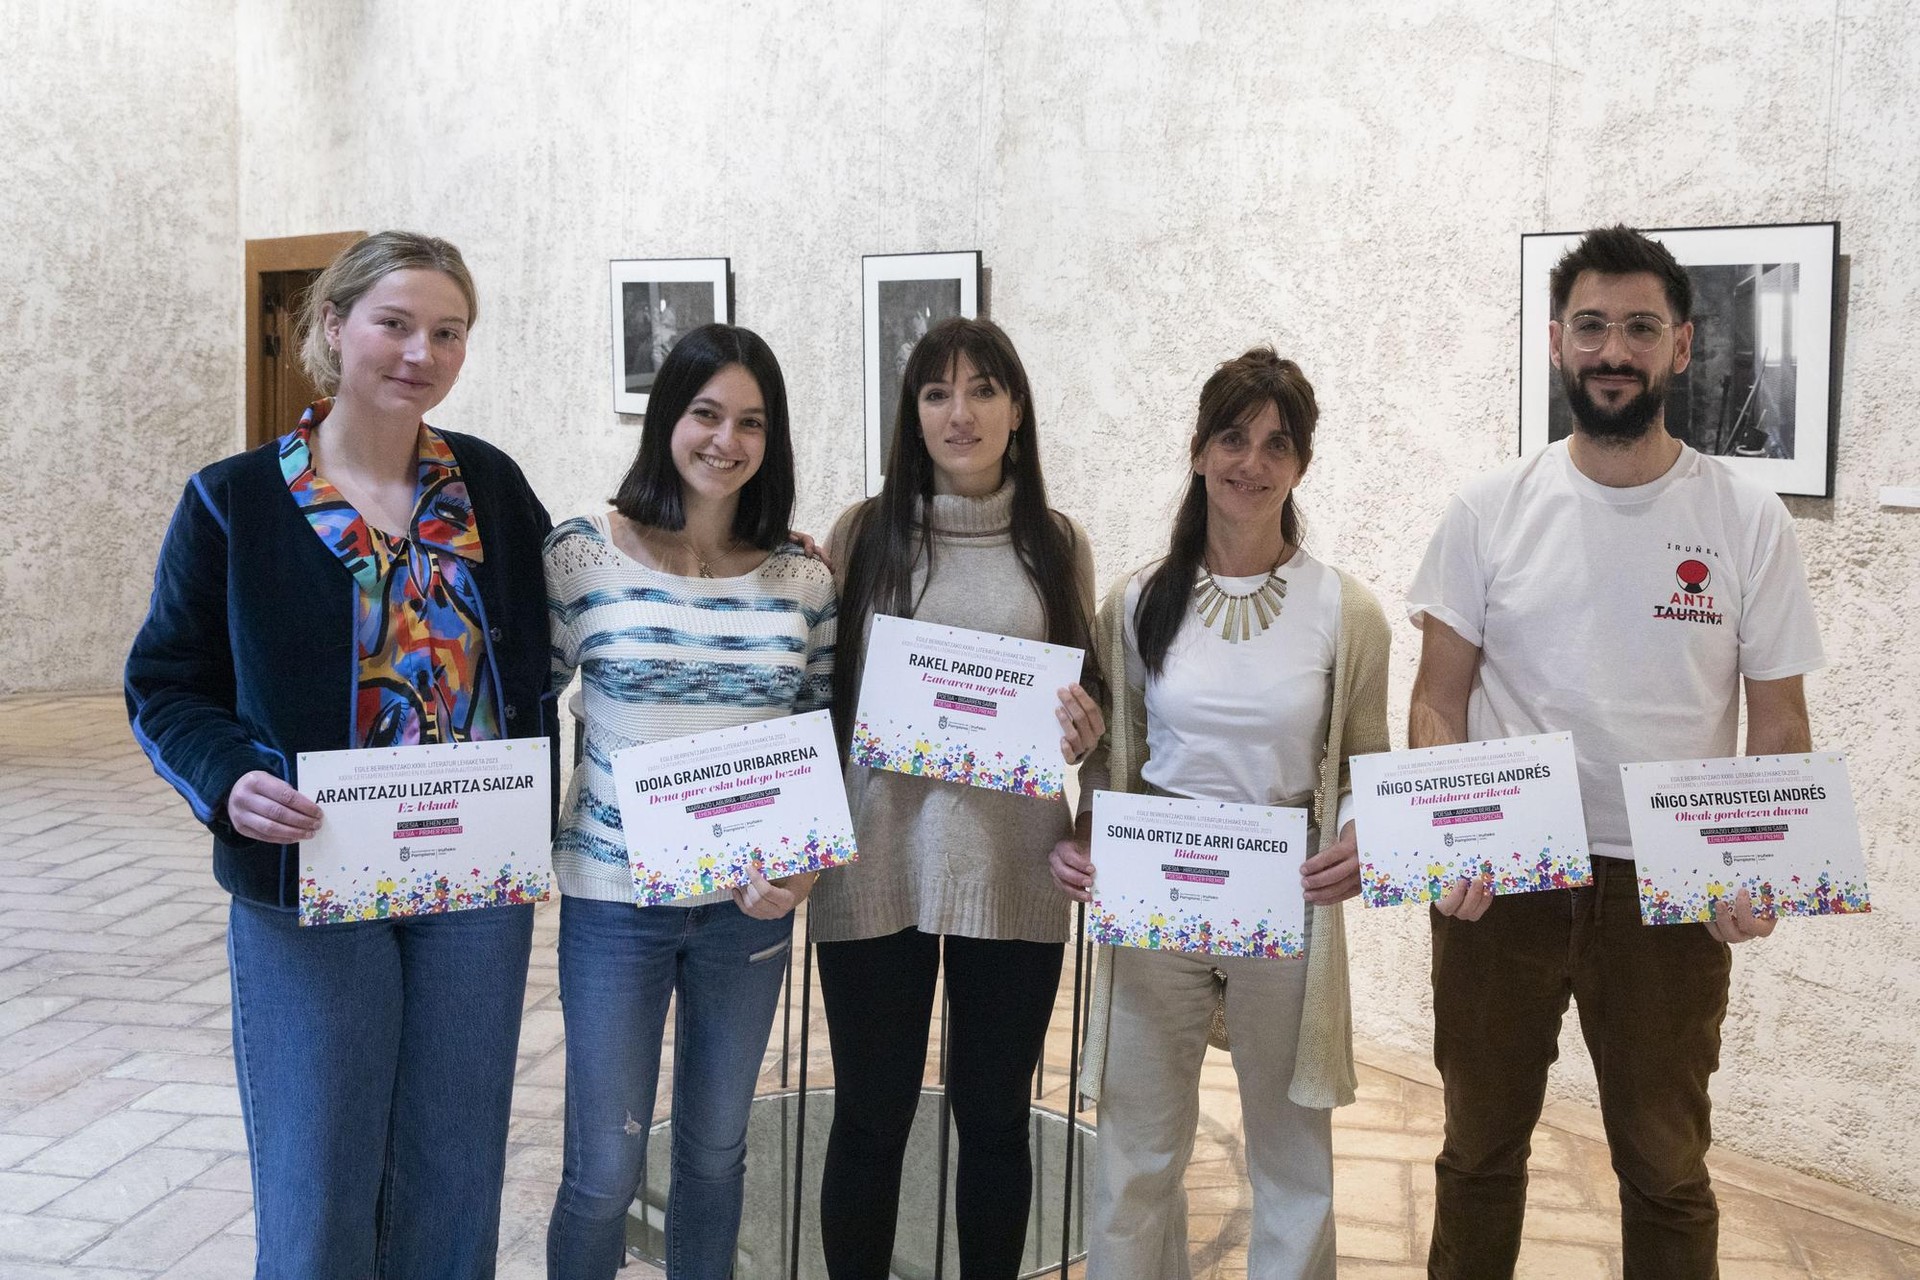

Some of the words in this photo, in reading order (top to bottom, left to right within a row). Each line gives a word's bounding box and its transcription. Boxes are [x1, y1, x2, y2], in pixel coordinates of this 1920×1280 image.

[1670, 592, 1714, 609] ANTI
[1654, 606, 1722, 625] TAURINA
[909, 654, 948, 671] RAKEL
[952, 661, 992, 679] PARDO
[995, 669, 1034, 686] PEREZ
[636, 776, 672, 793] IDOIA
[674, 763, 731, 785] GRANIZO
[734, 746, 818, 772] URIBARRENA
[1377, 781, 1412, 796] IÑIGO
[1415, 772, 1494, 792] SATRUSTEGI
[1498, 763, 1550, 782] ANDRÉS
[316, 784, 406, 804] ARANTZAZU
[411, 779, 480, 796] LIZARTZA
[483, 776, 533, 791] SAIZAR
[650, 794, 678, 804] Dena
[682, 788, 706, 800] gure
[710, 782, 732, 792] esku
[736, 774, 772, 786] balego
[776, 766, 810, 778] bezala
[1412, 793, 1470, 805] Ebakidura
[1473, 786, 1520, 798] ariketak
[1651, 793, 1687, 808] IÑIGO
[1690, 790, 1770, 806] SATRUSTEGI
[1774, 784, 1826, 802] ANDRÉS
[1714, 809, 1770, 822] gordetzen
[1773, 807, 1808, 816] duena
[1108, 825, 1145, 840] SONIA
[1148, 830, 1182, 844] ORTIZ
[1186, 833, 1201, 846] DE
[1204, 835, 1233, 849] ARRI
[1237, 838, 1287, 853] GARCEO
[1175, 849, 1218, 860] Bidasoa
